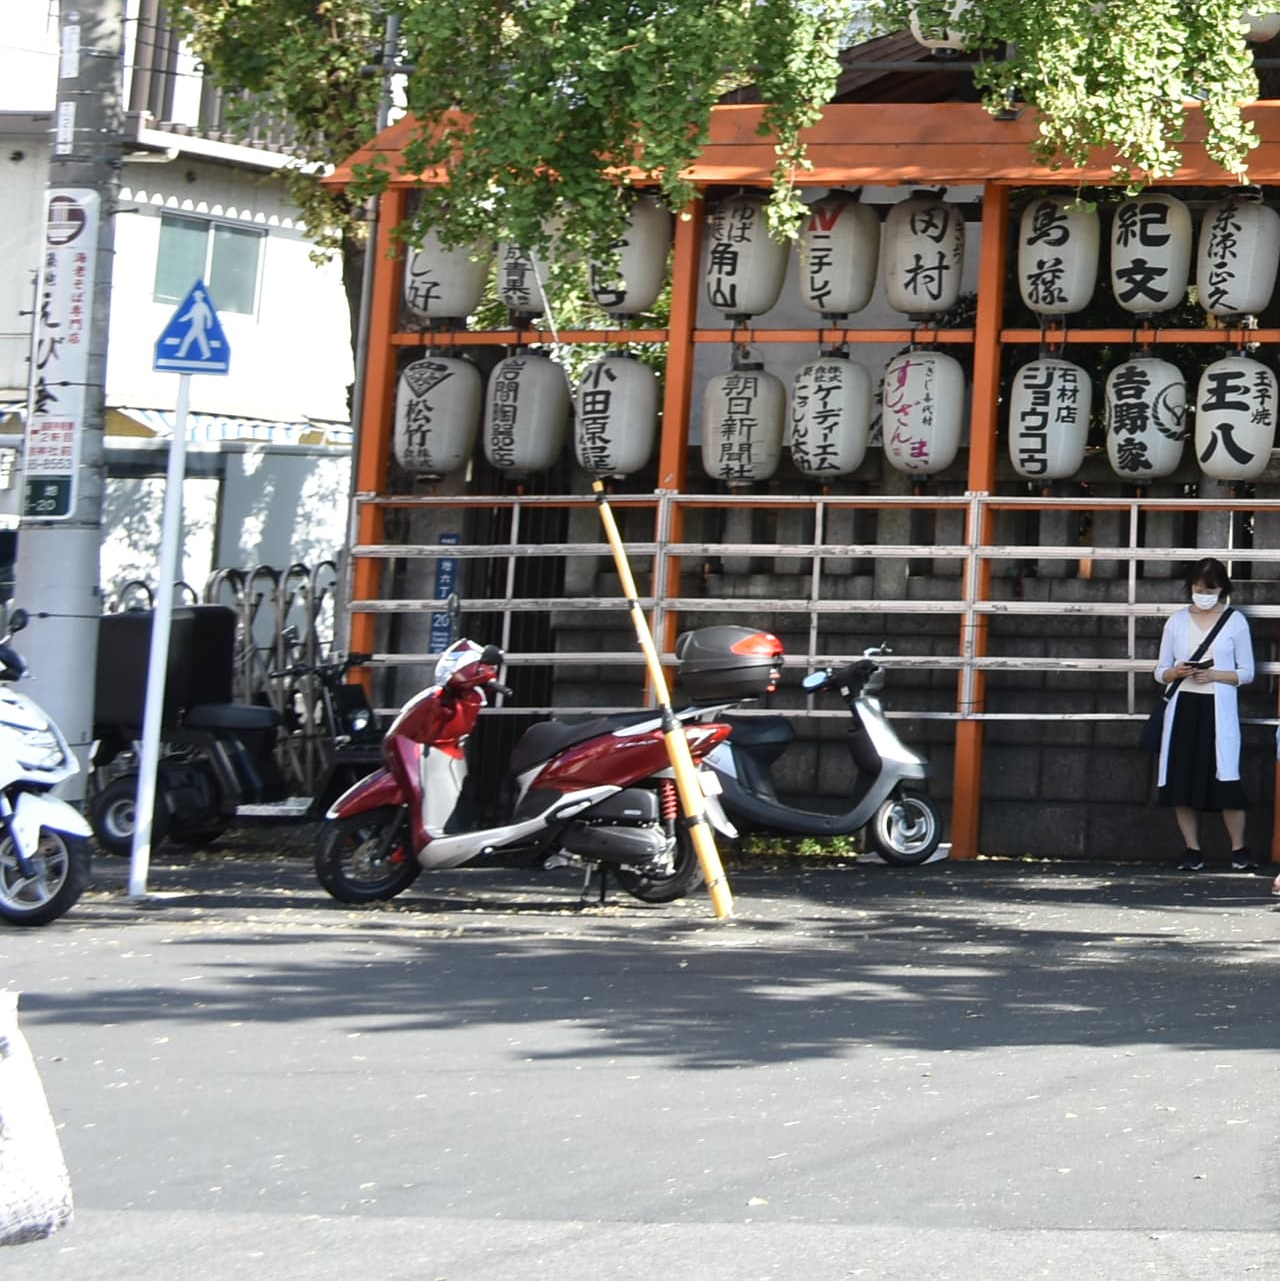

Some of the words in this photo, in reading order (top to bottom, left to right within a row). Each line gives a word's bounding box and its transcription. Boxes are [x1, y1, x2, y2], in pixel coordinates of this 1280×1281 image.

[727, 205, 755, 243] ゆば
[1116, 203, 1171, 303] 紀文
[706, 243, 739, 309] 角山
[810, 234, 832, 309] ニチレイ
[404, 399, 433, 448] 松竹
[581, 361, 618, 471] 小田原屋
[718, 374, 759, 480] 朝日新聞社
[811, 385, 843, 471] ケーディーエム
[1018, 367, 1056, 475] ジョウコウ
[1055, 368, 1080, 424] 石材店
[1113, 365, 1154, 473] 吉野家
[1201, 371, 1256, 465] 玉八
[1250, 371, 1273, 427] 玉子焼
